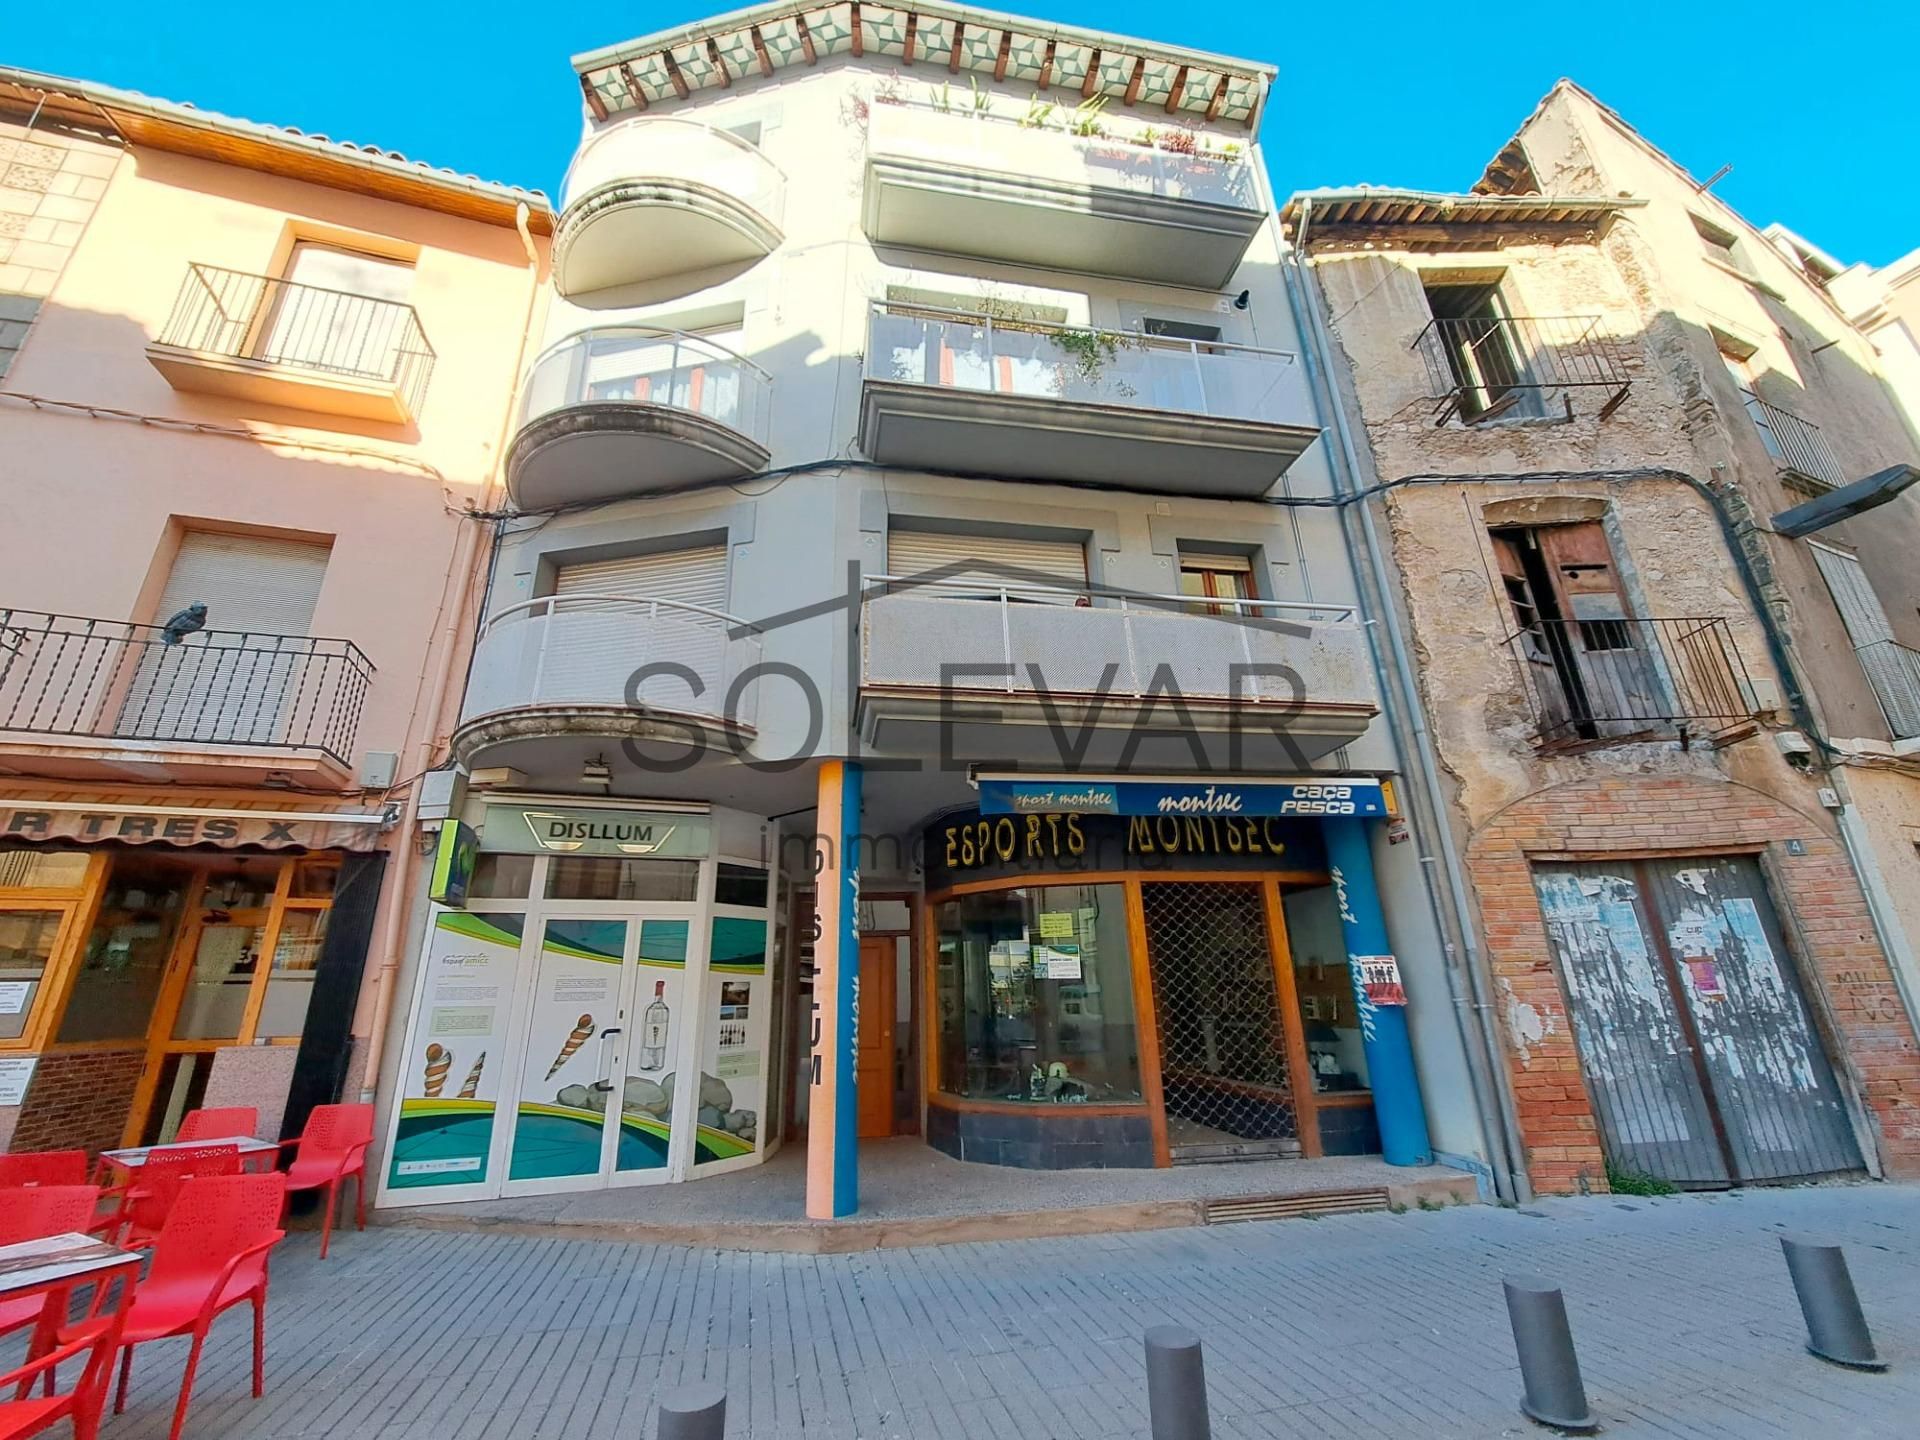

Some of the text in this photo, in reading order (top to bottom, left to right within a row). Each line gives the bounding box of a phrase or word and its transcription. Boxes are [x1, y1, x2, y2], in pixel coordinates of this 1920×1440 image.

[1016, 787, 1113, 807] sport montsec
[1157, 785, 1243, 813] montsec
[1292, 785, 1352, 800] caça
[7, 811, 299, 842] R TRES X
[549, 821, 653, 841] DISLLUM
[945, 812, 1286, 868] ESPORTS MONTSEC
[1791, 840, 1801, 853] 4
[1331, 865, 1359, 924] sport
